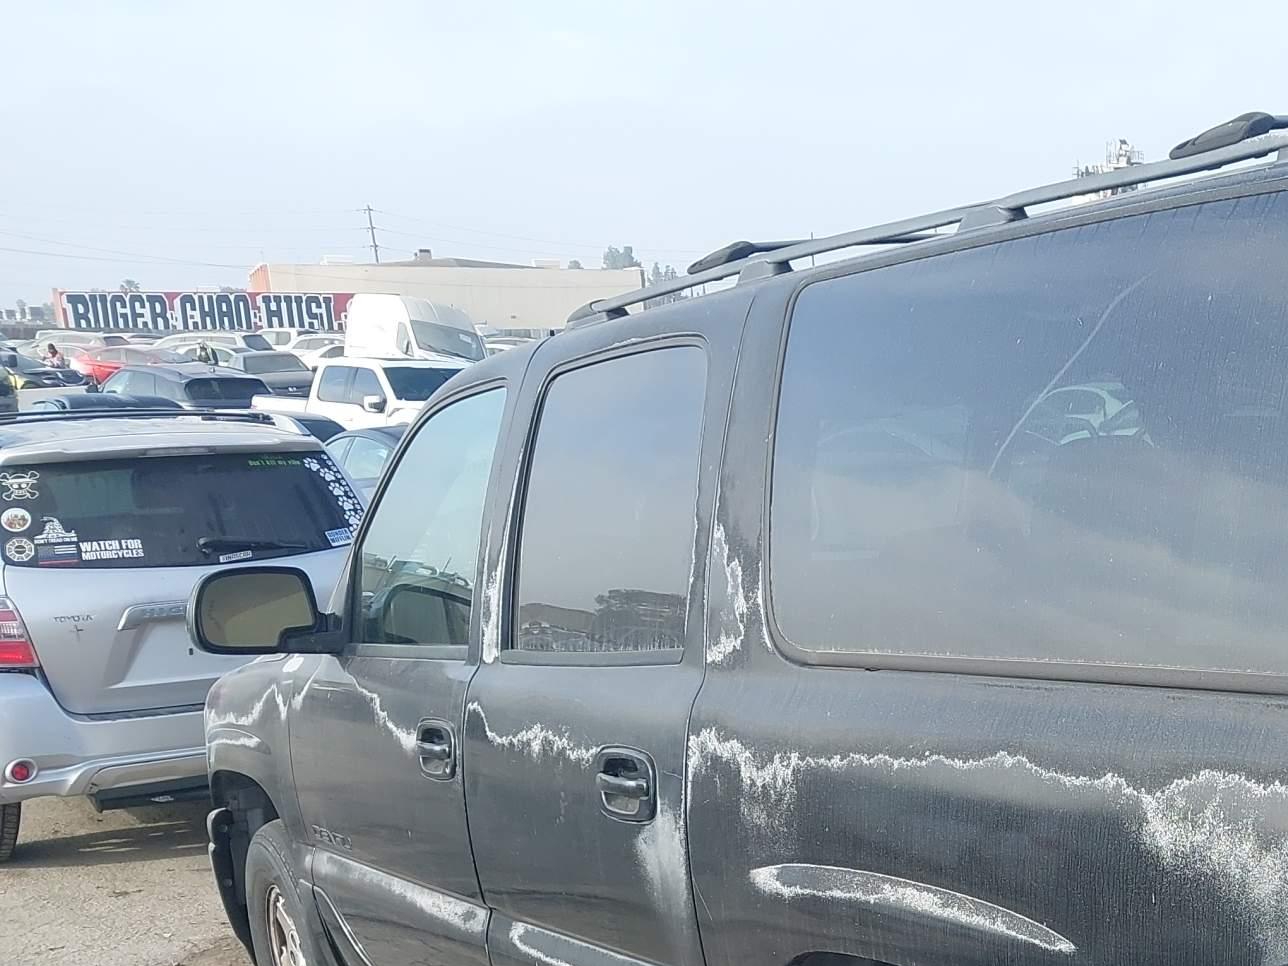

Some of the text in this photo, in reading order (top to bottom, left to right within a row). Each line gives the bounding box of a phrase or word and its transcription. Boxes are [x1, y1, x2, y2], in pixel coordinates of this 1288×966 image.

[79, 539, 143, 552] WATCH FOR
[82, 549, 145, 560] MOTORCYCLES
